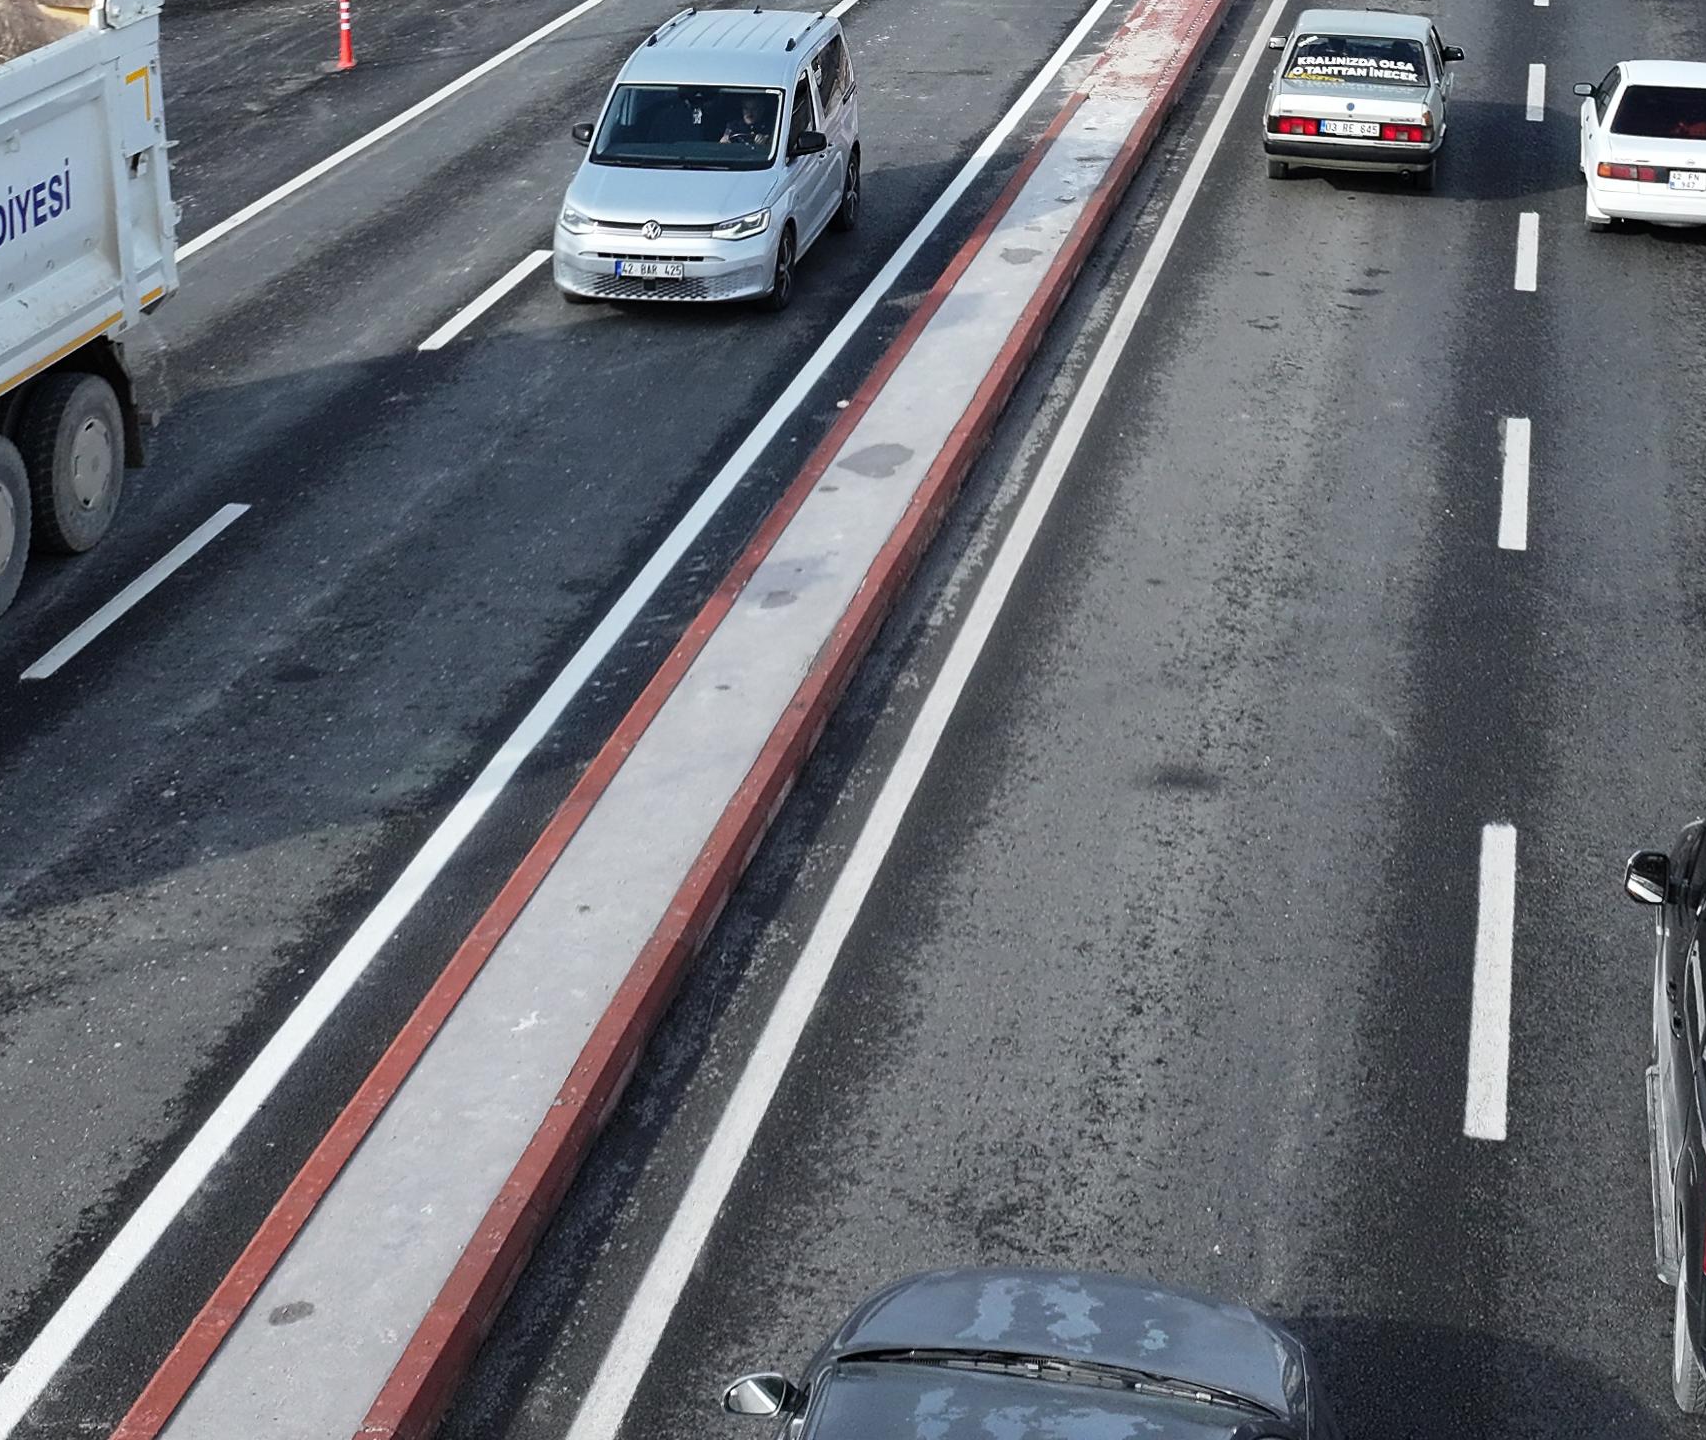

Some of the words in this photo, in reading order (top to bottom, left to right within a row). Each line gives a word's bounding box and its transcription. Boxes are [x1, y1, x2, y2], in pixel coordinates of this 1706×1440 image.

[1379, 60, 1415, 72] OLSA
[1292, 67, 1304, 76] O
[1305, 67, 1367, 78] TAHTTAN
[1325, 123, 1338, 132] 03
[622, 263, 634, 274] 42
